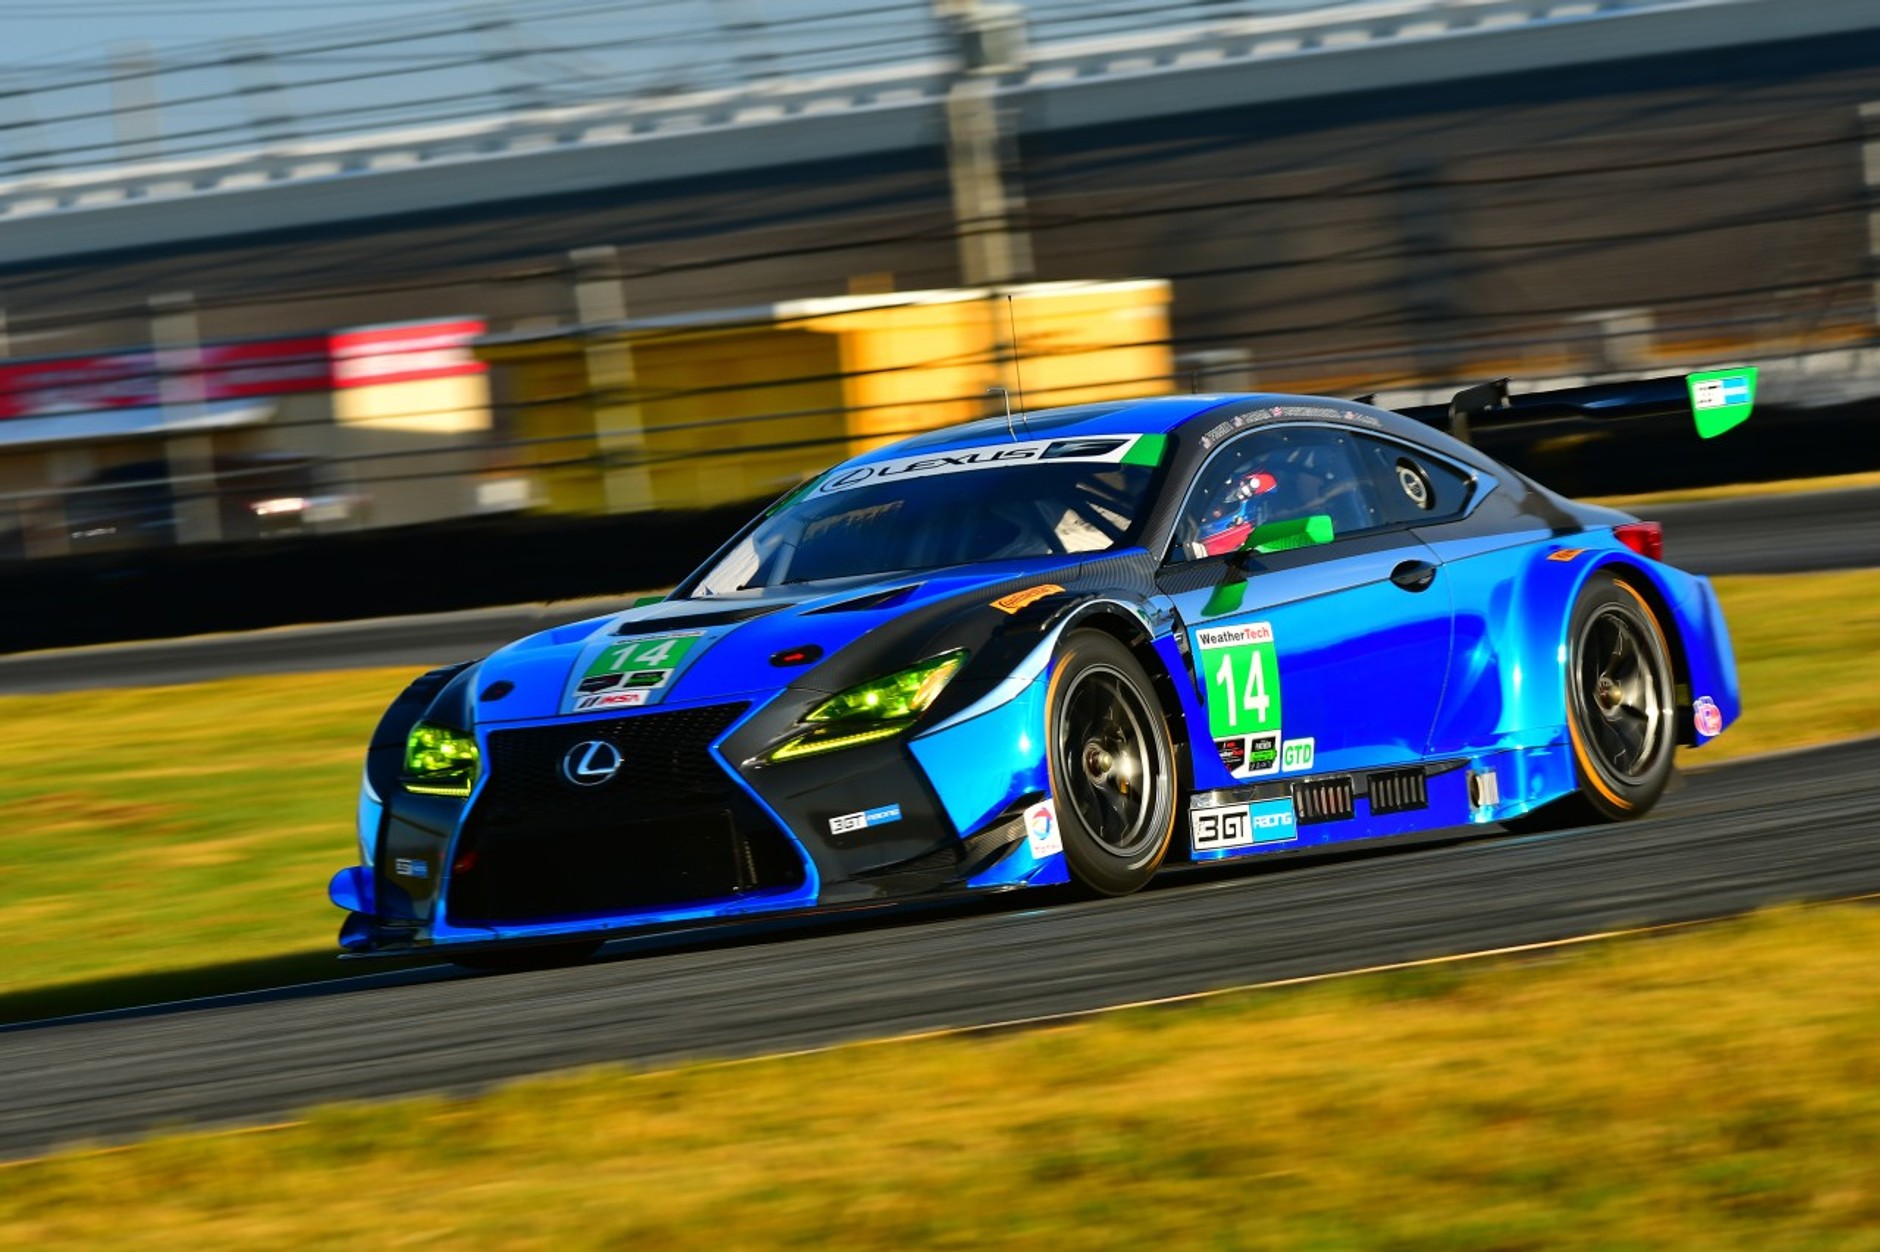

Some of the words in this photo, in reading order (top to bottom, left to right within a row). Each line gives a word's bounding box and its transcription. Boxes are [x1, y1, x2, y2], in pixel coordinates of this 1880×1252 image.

[877, 448, 1039, 476] LEXUS
[1199, 626, 1270, 646] WeatherTech
[609, 639, 677, 671] 14
[1216, 651, 1270, 726] 14
[1284, 743, 1312, 767] GTD
